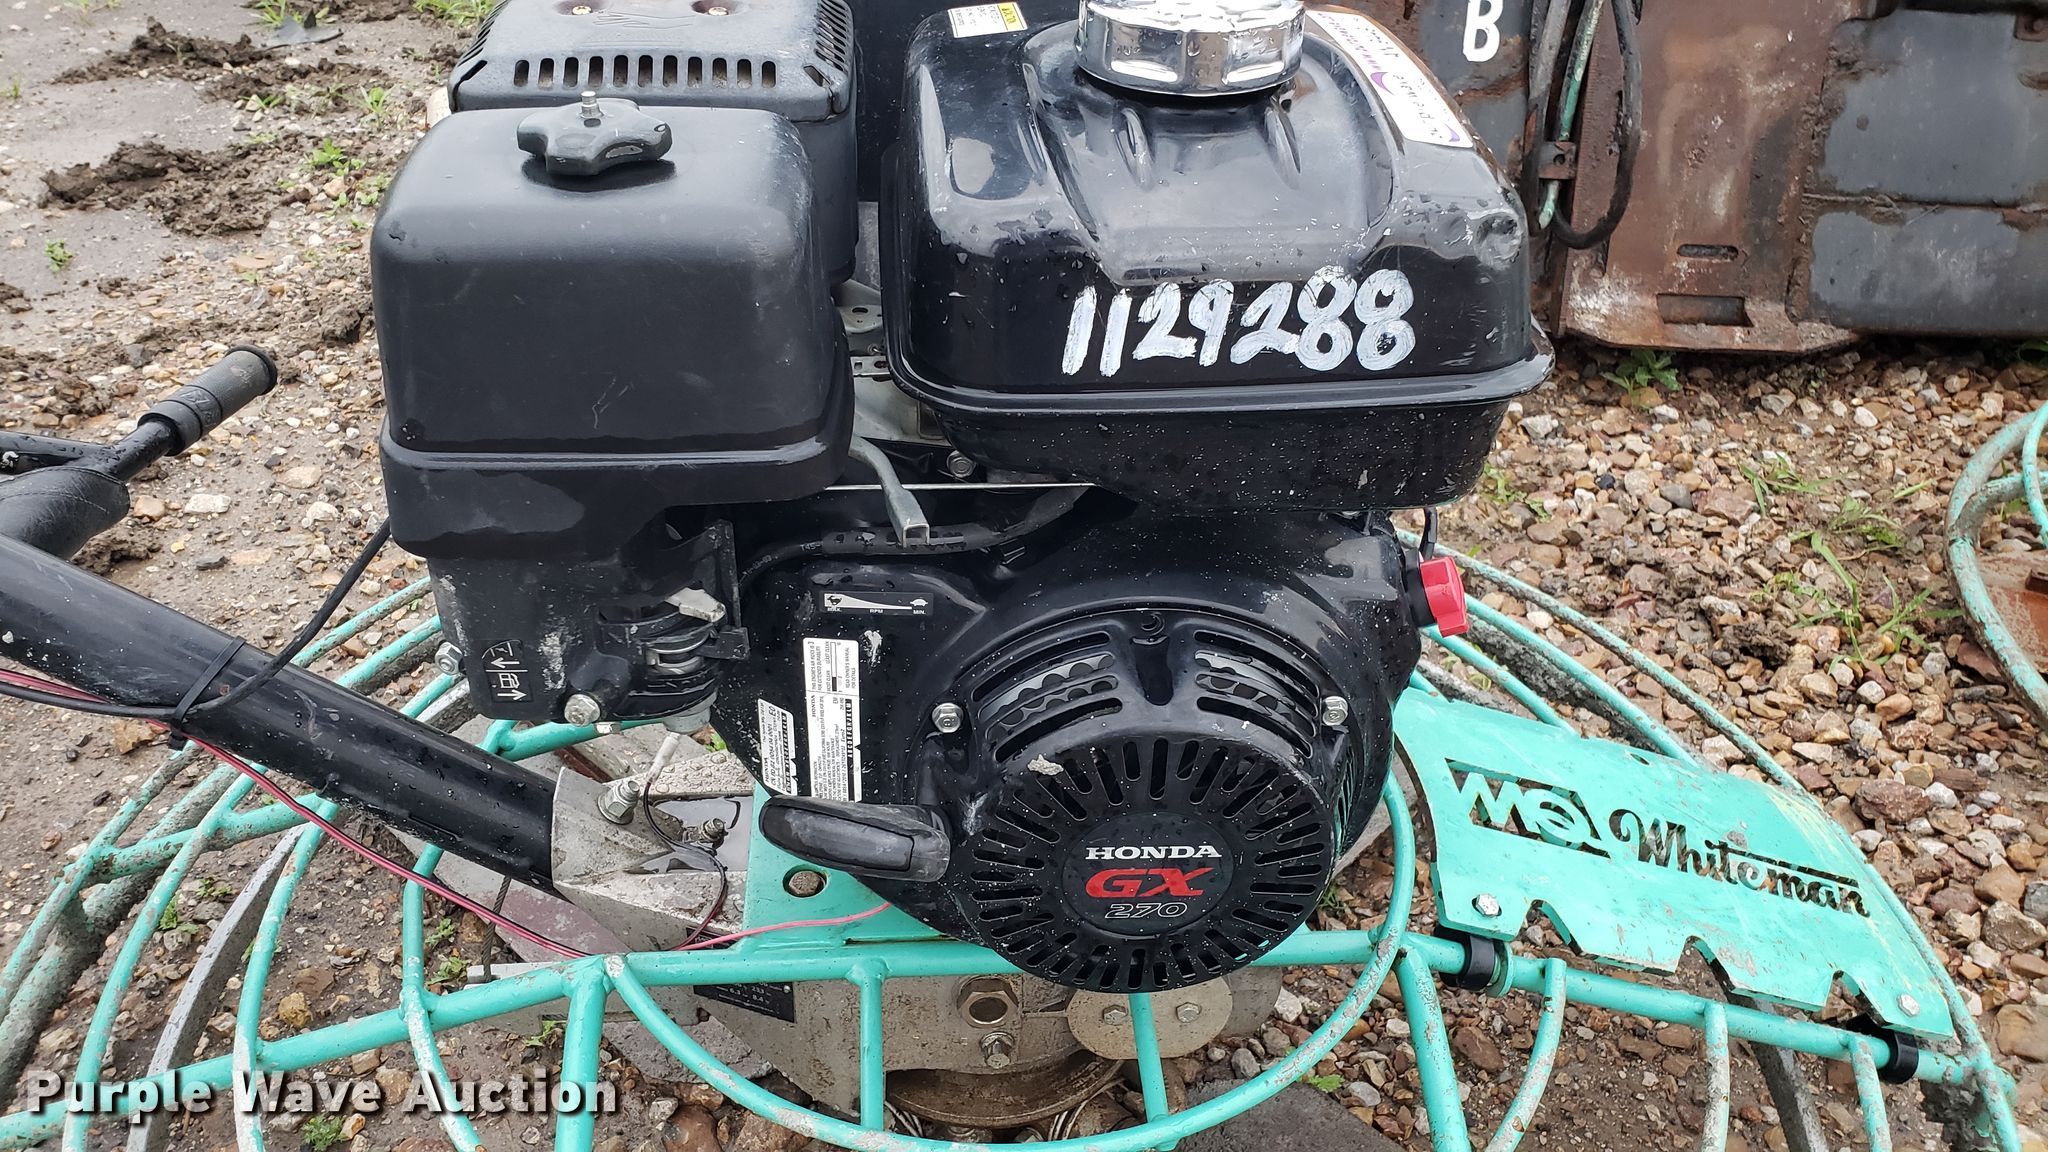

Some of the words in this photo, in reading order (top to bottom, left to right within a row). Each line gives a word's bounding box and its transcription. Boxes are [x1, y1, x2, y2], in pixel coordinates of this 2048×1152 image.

[1463, 0, 1503, 62] B
[1062, 265, 1415, 377] 1129288
[1085, 845, 1222, 860] HONDA
[1609, 808, 1870, 918] Whiteman
[1086, 867, 1214, 898] GX
[1105, 902, 1187, 919] 270
